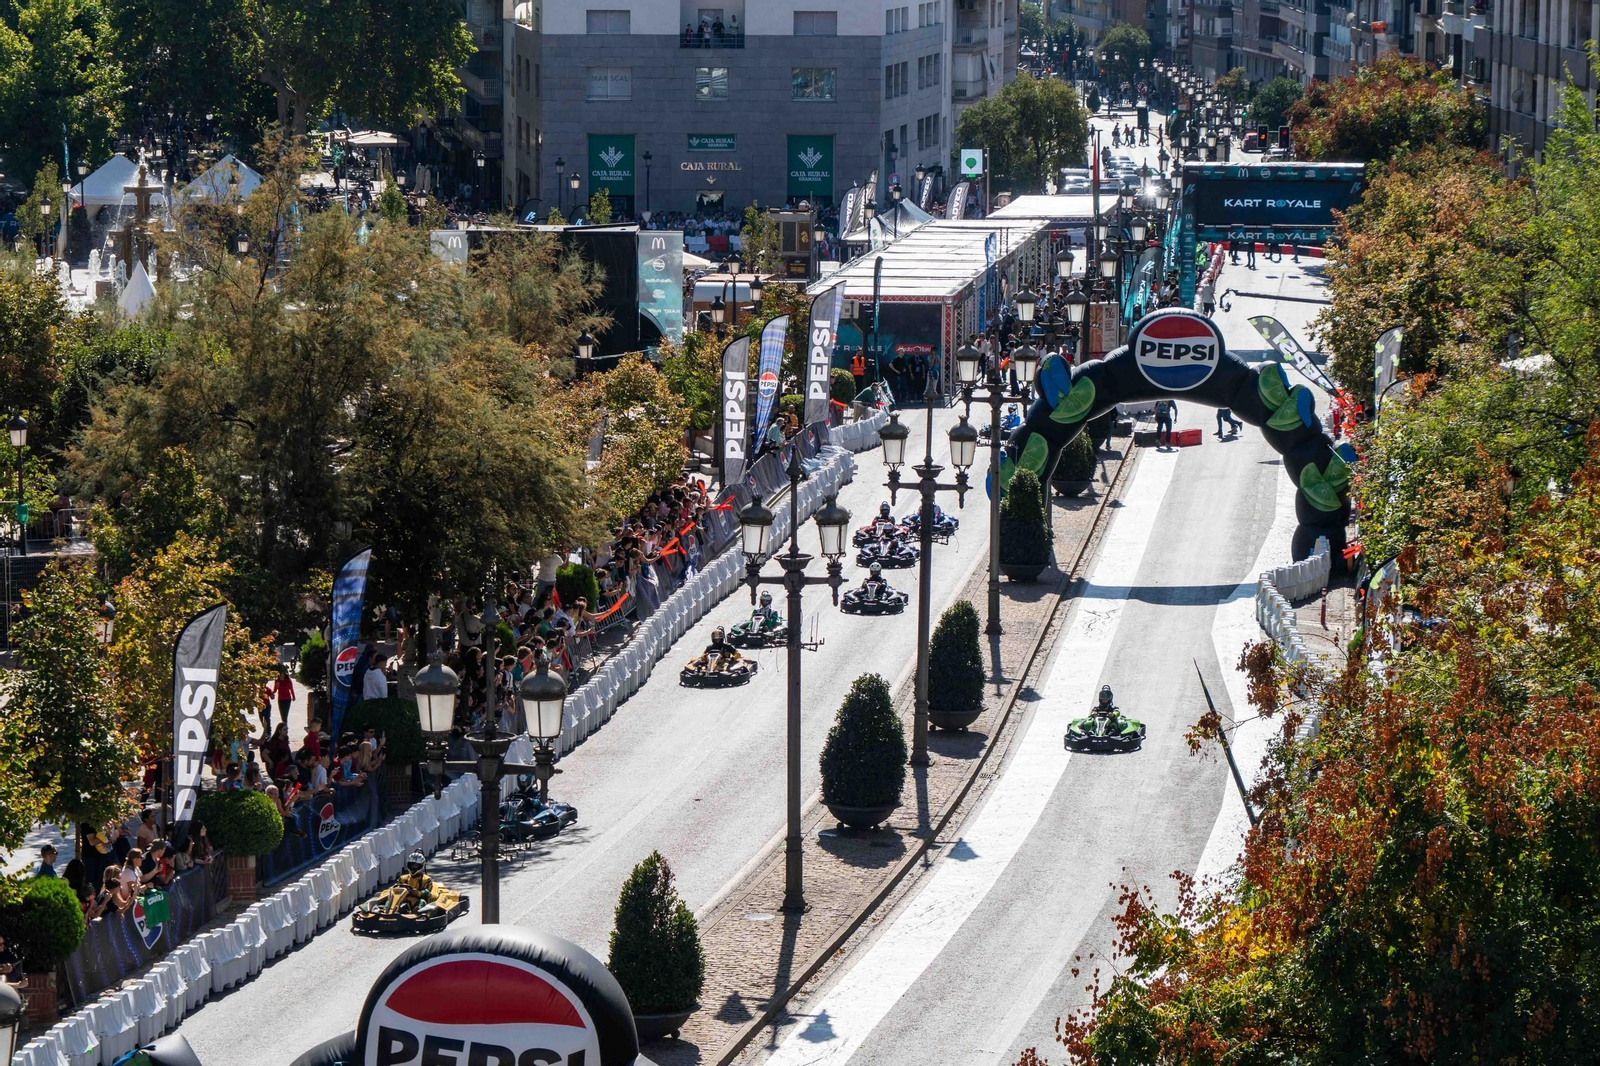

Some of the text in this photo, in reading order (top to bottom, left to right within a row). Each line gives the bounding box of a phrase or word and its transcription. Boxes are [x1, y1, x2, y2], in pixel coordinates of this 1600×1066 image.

[681, 162, 742, 171] CAJA RURAL
[1224, 198, 1321, 209] KART ROYALE
[1227, 231, 1262, 240] KART
[1266, 232, 1317, 240] ROYALE
[1137, 280, 1146, 305] KART
[809, 319, 831, 400] PEPSI
[1140, 340, 1215, 361] PEPSI
[725, 371, 746, 459] PEPSI
[336, 662, 355, 672] PEP
[175, 667, 217, 822] PEPSI
